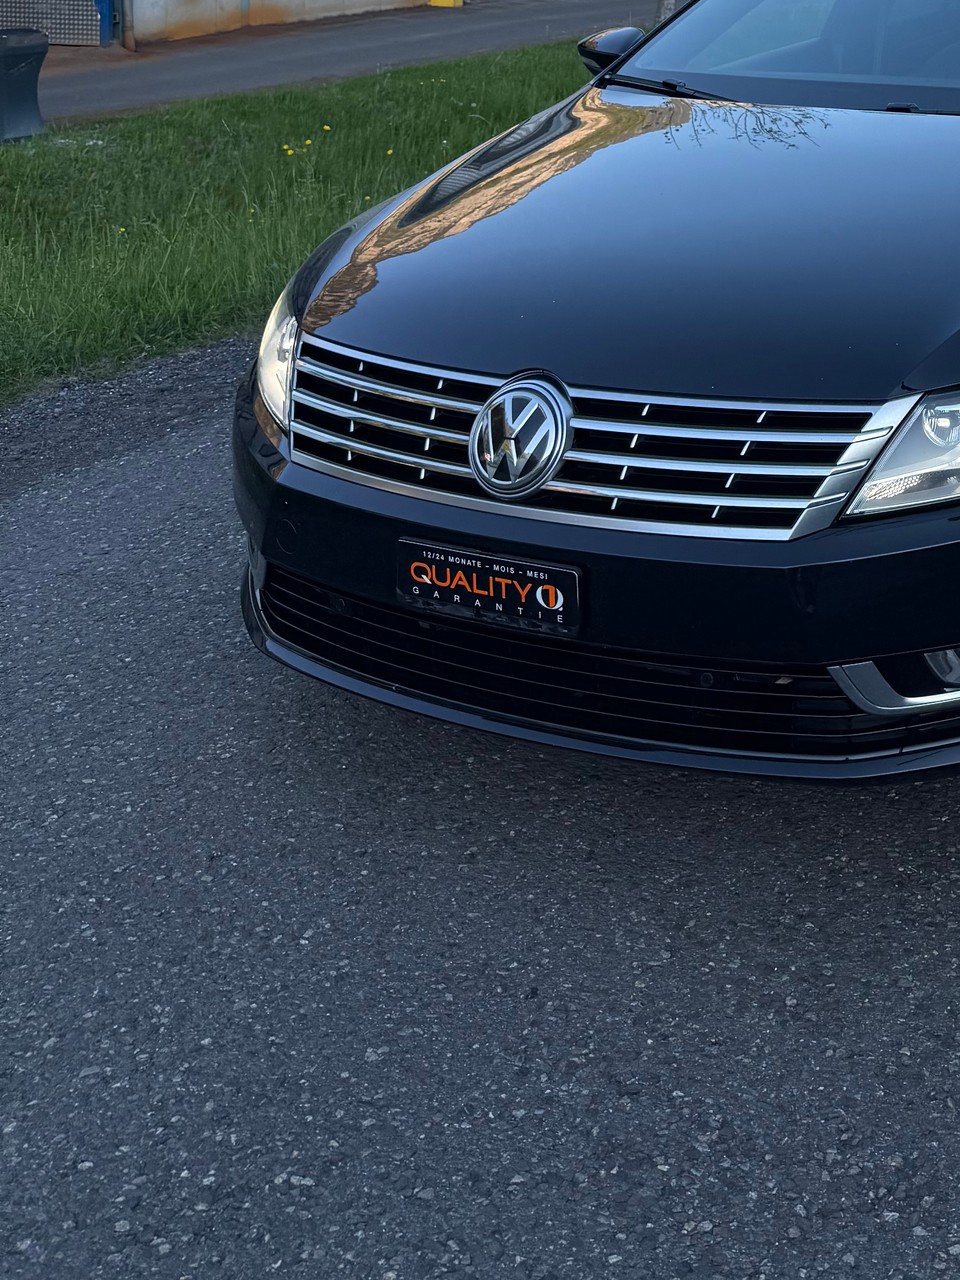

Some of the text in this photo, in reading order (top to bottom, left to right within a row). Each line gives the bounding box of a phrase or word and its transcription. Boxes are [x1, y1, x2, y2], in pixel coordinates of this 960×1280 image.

[410, 561, 533, 603] QUALITY
[422, 550, 445, 561] 12/24
[448, 555, 482, 568] MONATE
[493, 563, 515, 574] MOIS
[527, 569, 548, 580] MESI
[412, 586, 563, 623] GARANTIE
